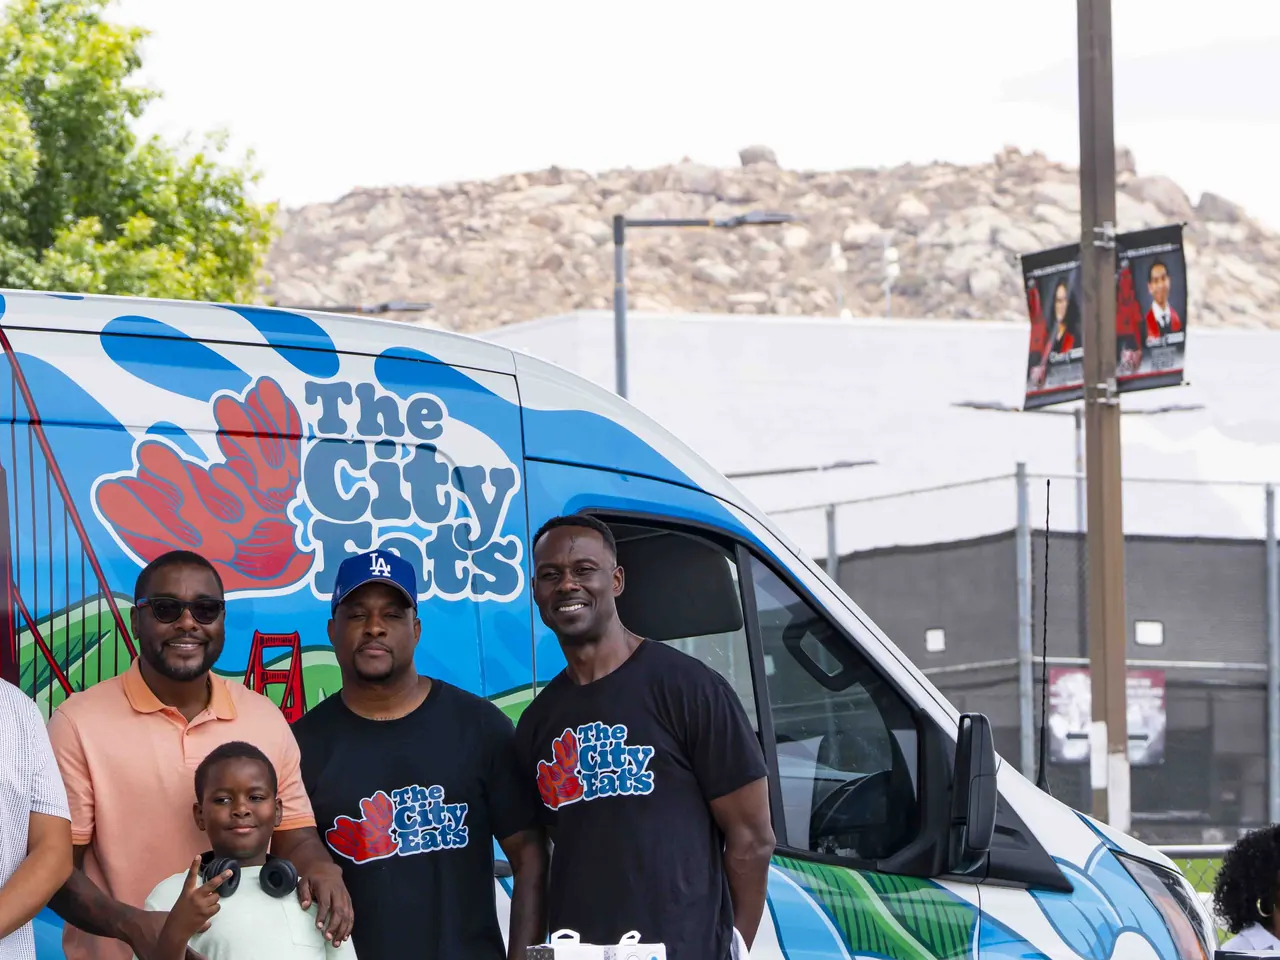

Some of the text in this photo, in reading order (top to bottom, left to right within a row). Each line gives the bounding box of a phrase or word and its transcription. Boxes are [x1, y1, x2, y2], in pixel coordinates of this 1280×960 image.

[304, 381, 444, 441] The
[303, 438, 516, 551] City
[370, 553, 391, 577] LA
[578, 722, 627, 745] The
[578, 741, 654, 778] City
[392, 785, 444, 806] The
[581, 767, 654, 800] Eats
[393, 800, 467, 833] City
[397, 826, 468, 855] Eats
